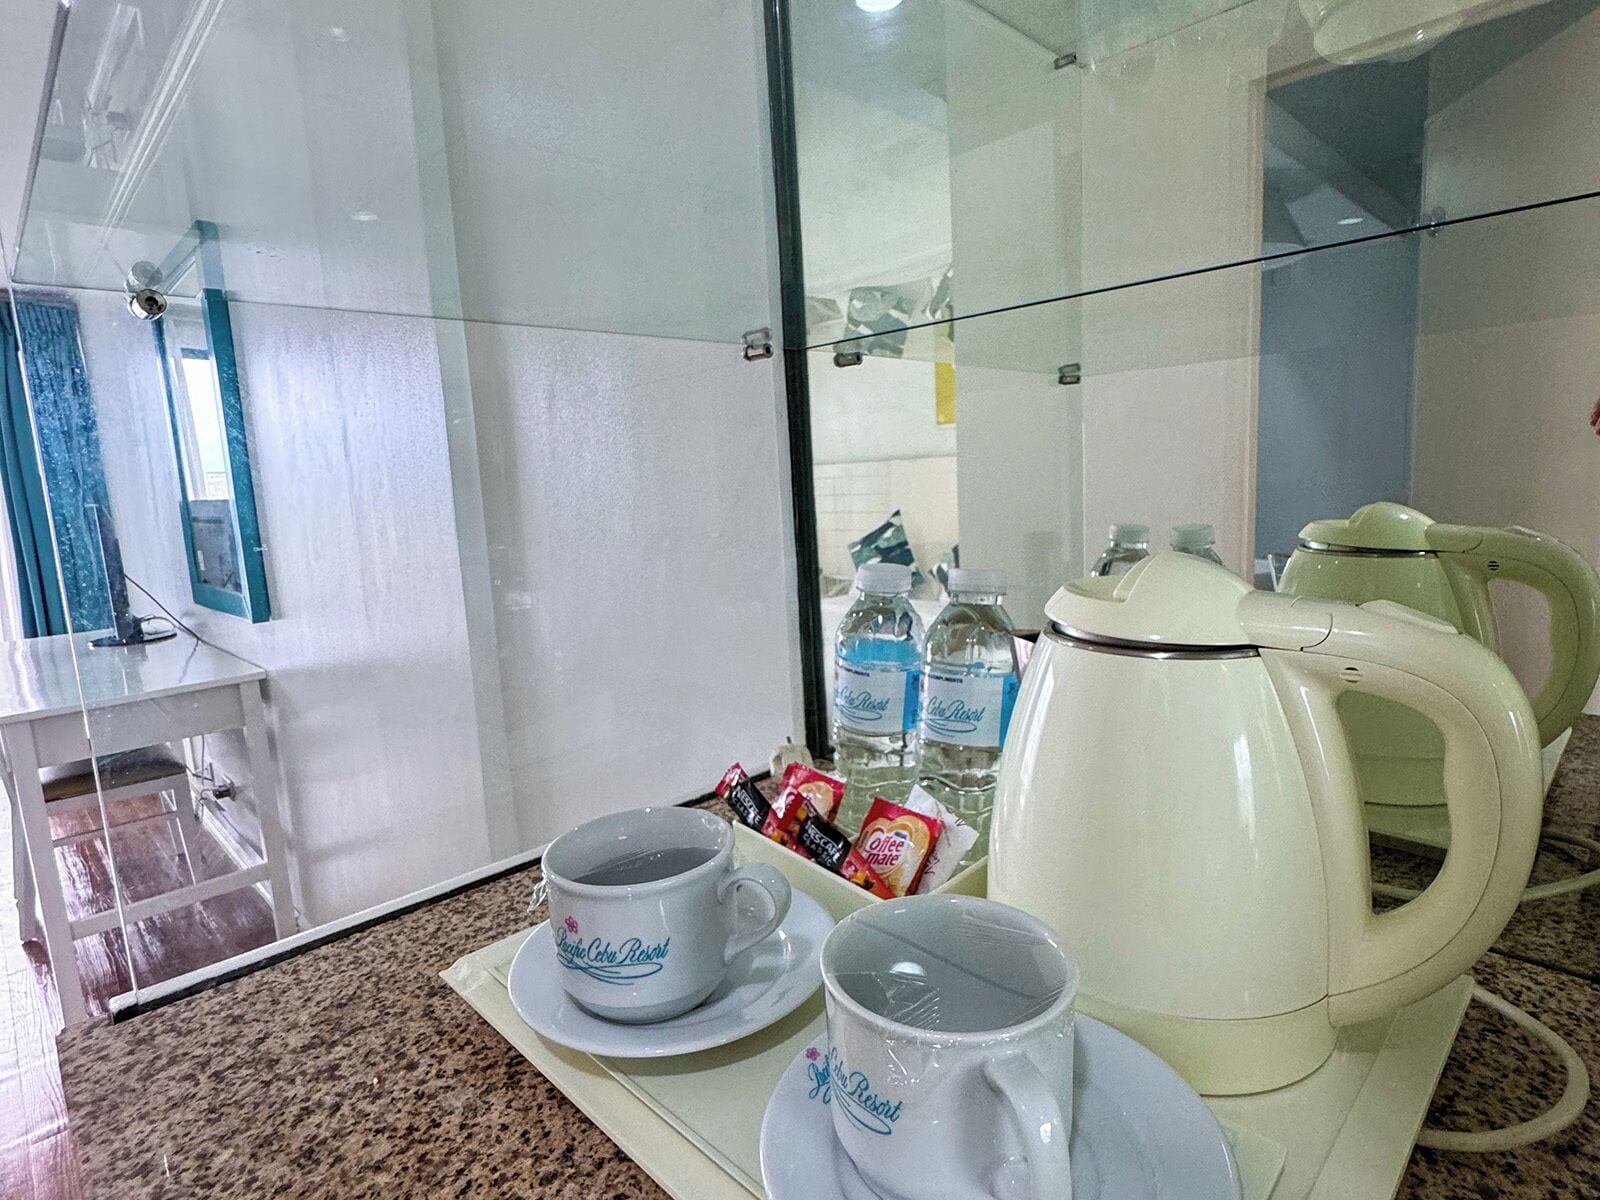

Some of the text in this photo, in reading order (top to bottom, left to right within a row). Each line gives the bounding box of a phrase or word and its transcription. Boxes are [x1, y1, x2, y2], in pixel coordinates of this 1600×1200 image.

[945, 699, 986, 722] Resort
[866, 852, 902, 866] mate
[586, 937, 619, 964] Cebu
[616, 936, 671, 965] Resort
[847, 1071, 903, 1122] Resort
